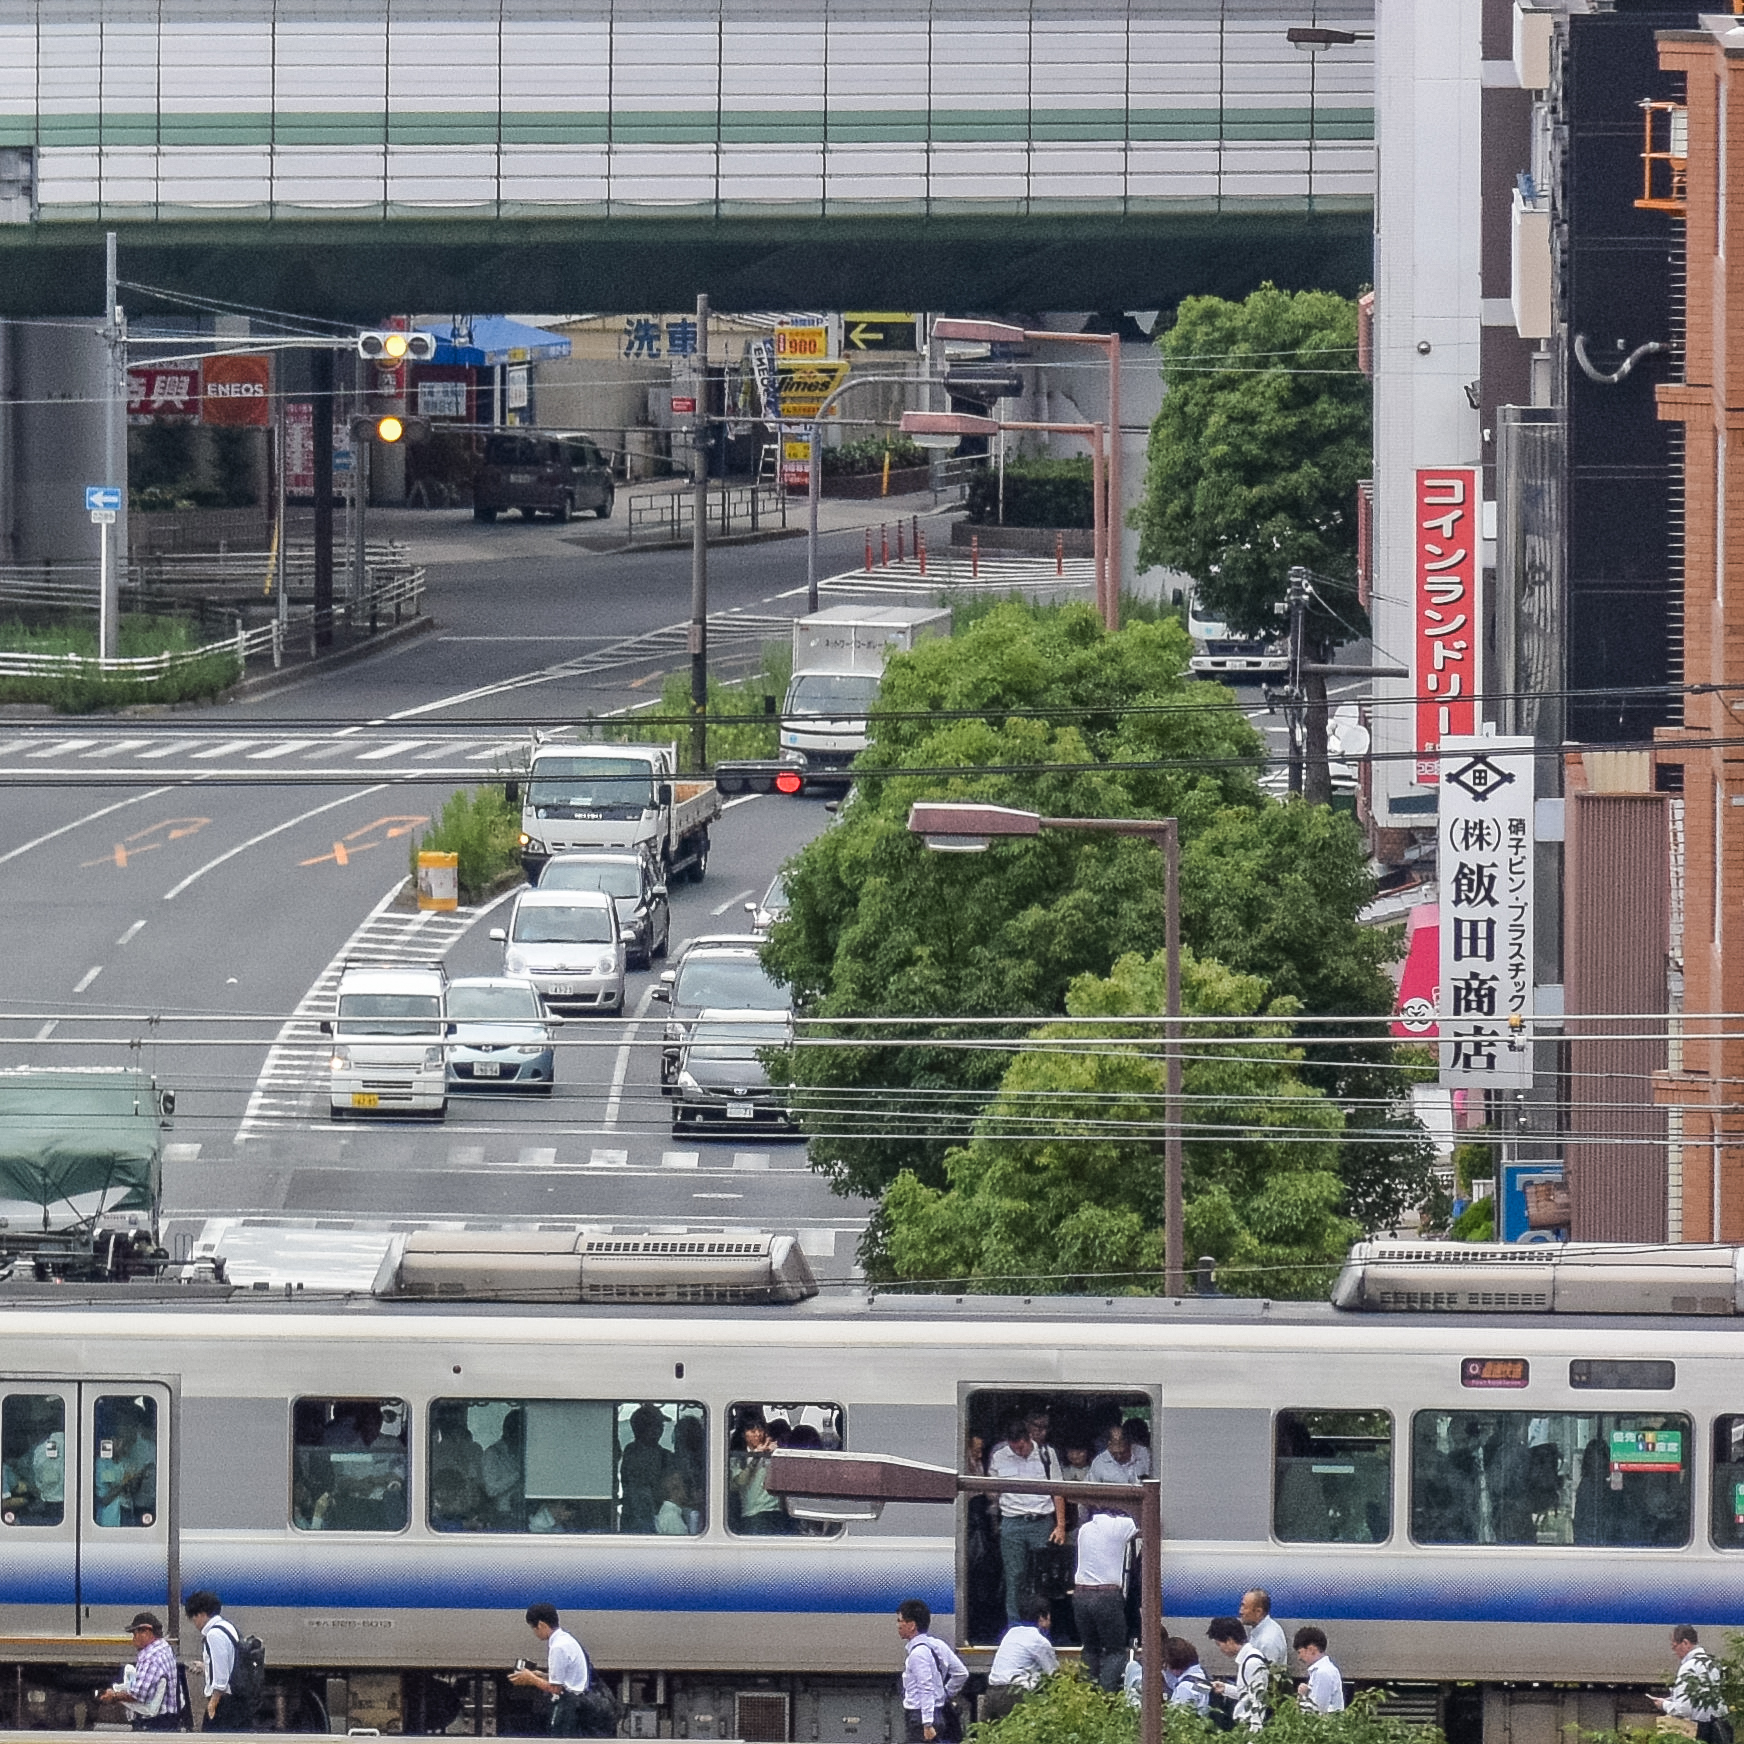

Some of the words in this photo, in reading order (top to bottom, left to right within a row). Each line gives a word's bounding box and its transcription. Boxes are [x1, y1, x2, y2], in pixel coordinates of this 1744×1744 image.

[624, 318, 696, 358] 洗車
[206, 383, 265, 398] ENEOS
[1423, 479, 1468, 735] コインランドリー
